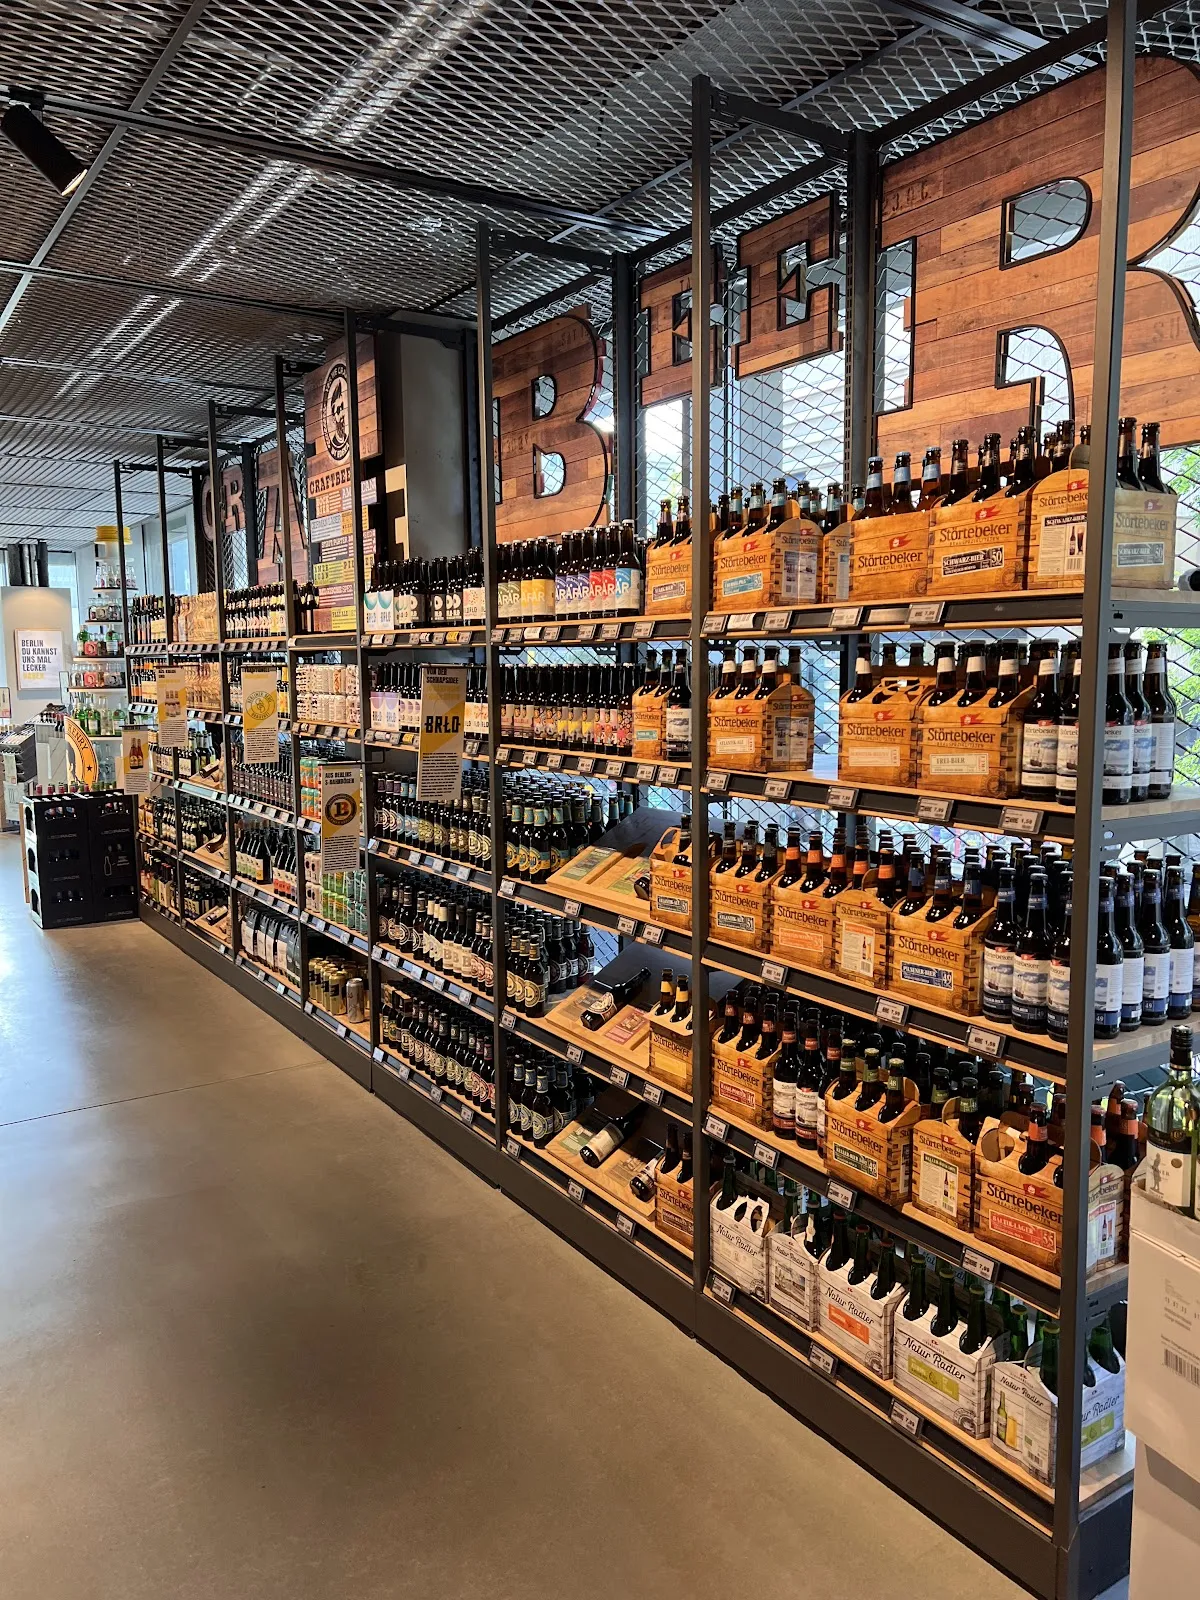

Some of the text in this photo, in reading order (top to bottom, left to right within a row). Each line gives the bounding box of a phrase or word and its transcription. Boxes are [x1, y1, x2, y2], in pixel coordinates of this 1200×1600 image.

[309, 467, 351, 495] CRAFTBEE
[1039, 491, 1088, 508] Störtebeke
[1115, 513, 1170, 531] Störtebeker
[939, 523, 1012, 543] Störtebeker
[720, 553, 768, 569] Störtebeker
[858, 551, 923, 569] Störtebeker
[991, 551, 1002, 562] 50
[651, 562, 690, 576] Störtebeker
[714, 716, 760, 728] Störtebeker
[847, 723, 907, 738] Störtebeker
[928, 728, 996, 743] Störtebeker
[654, 877, 692, 892] Störtebeker
[714, 891, 760, 911] Störtebeker
[777, 906, 829, 927] Störtebeker
[841, 906, 879, 921] Störtebeker
[899, 936, 960, 962] Störtebeker
[717, 1058, 760, 1087] Störtebeker
[831, 1118, 884, 1154] Störtebeker
[919, 1135, 963, 1158] Störtebeker
[987, 1182, 1064, 1225] Störtebeker
[717, 1224, 758, 1257] Natur Radler
[1042, 1231, 1054, 1246] 55
[775, 1246, 806, 1268] Natur Radler
[825, 1287, 847, 1308] Natur
[848, 1301, 875, 1326] Radler
[903, 1337, 931, 1359] Natur
[933, 1353, 966, 1381] Radler
[1000, 1376, 1044, 1408] Natur Radler
[1092, 1395, 1120, 1416] Radler
